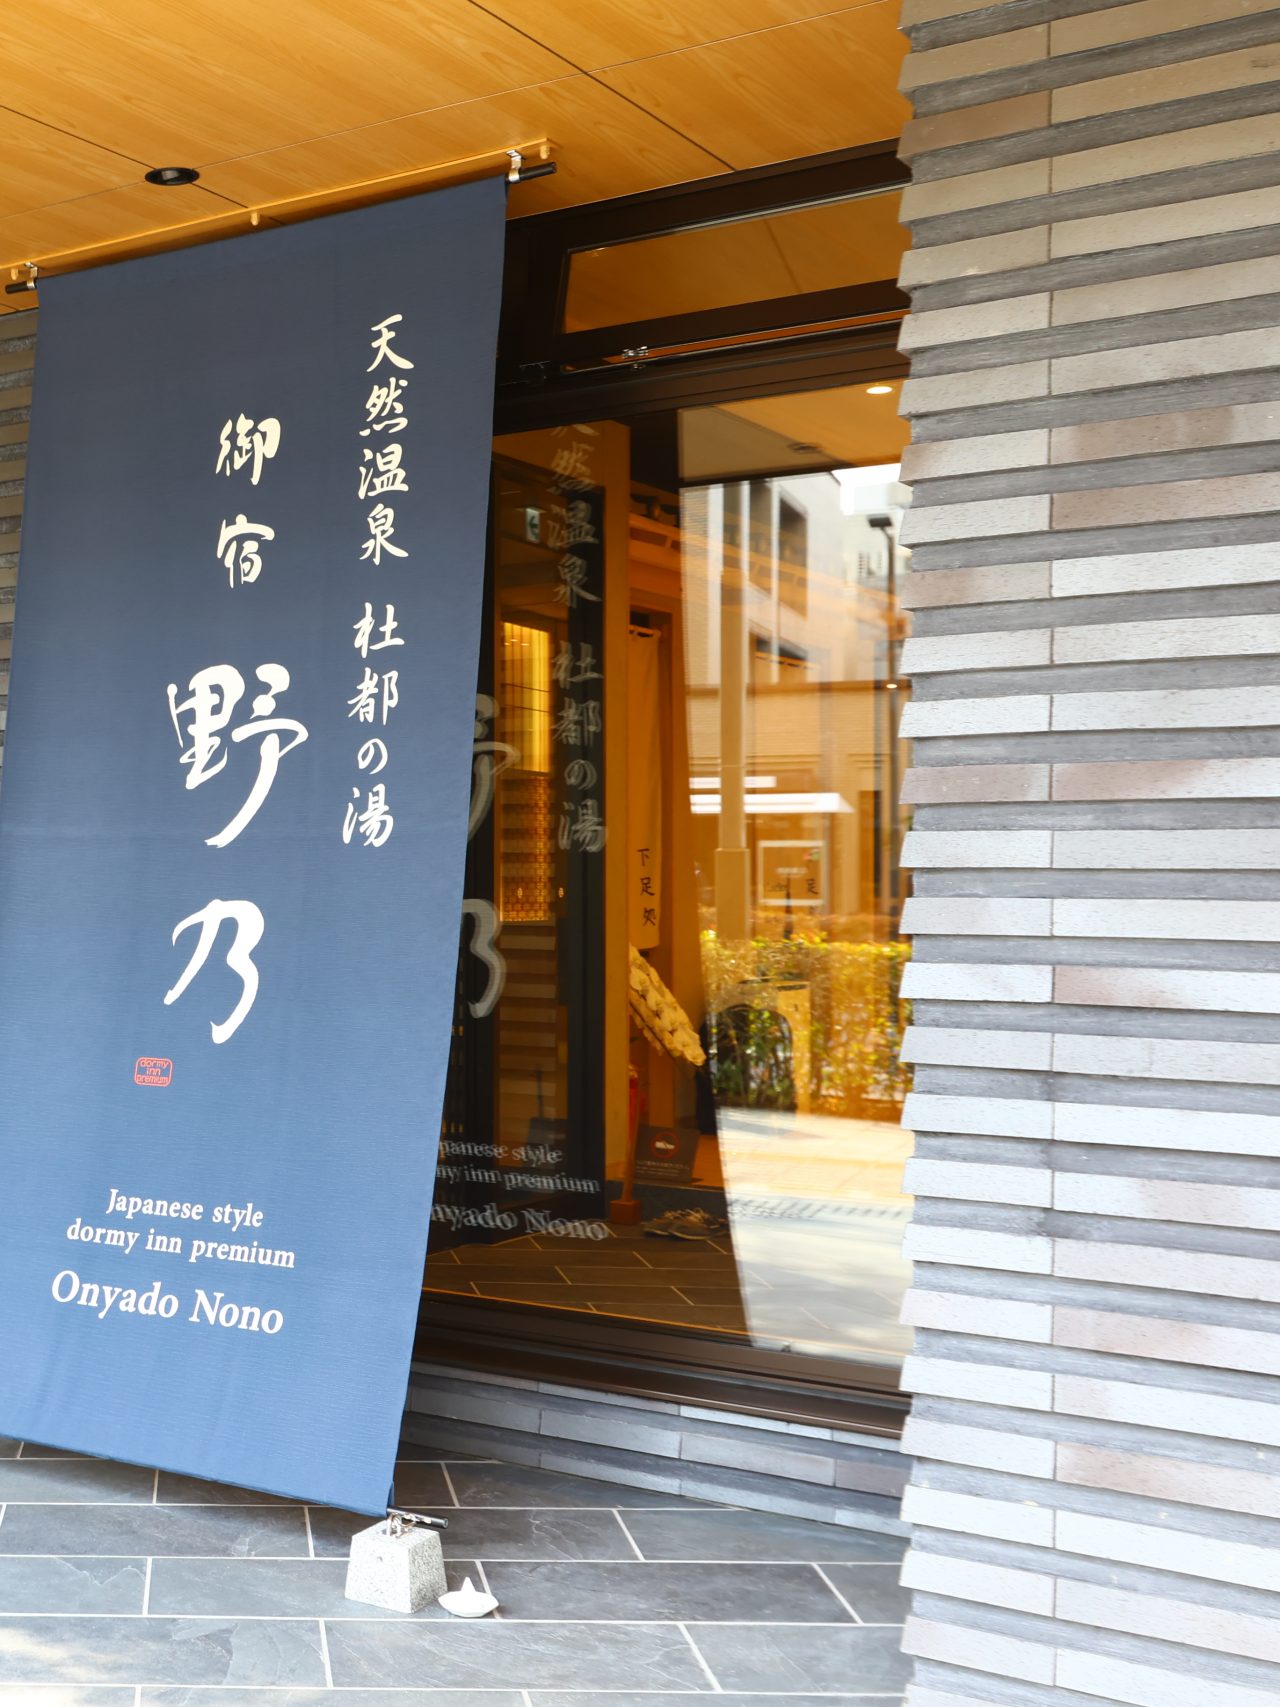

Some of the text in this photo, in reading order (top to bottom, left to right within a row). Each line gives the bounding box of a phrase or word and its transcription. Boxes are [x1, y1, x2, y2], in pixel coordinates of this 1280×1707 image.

[341, 313, 415, 848] 天然温泉 杜都の湯
[163, 412, 309, 1045] 御宿 野乃
[636, 848, 656, 927] 下足処
[136, 1074, 169, 1084] premium
[139, 1059, 169, 1069] dormy
[146, 1067, 161, 1076] inn
[106, 1188, 264, 1232] Japanese style
[431, 1202, 518, 1232] nyado
[66, 1217, 295, 1268] dormy inn premium
[51, 1270, 284, 1334] Onyado Nono
